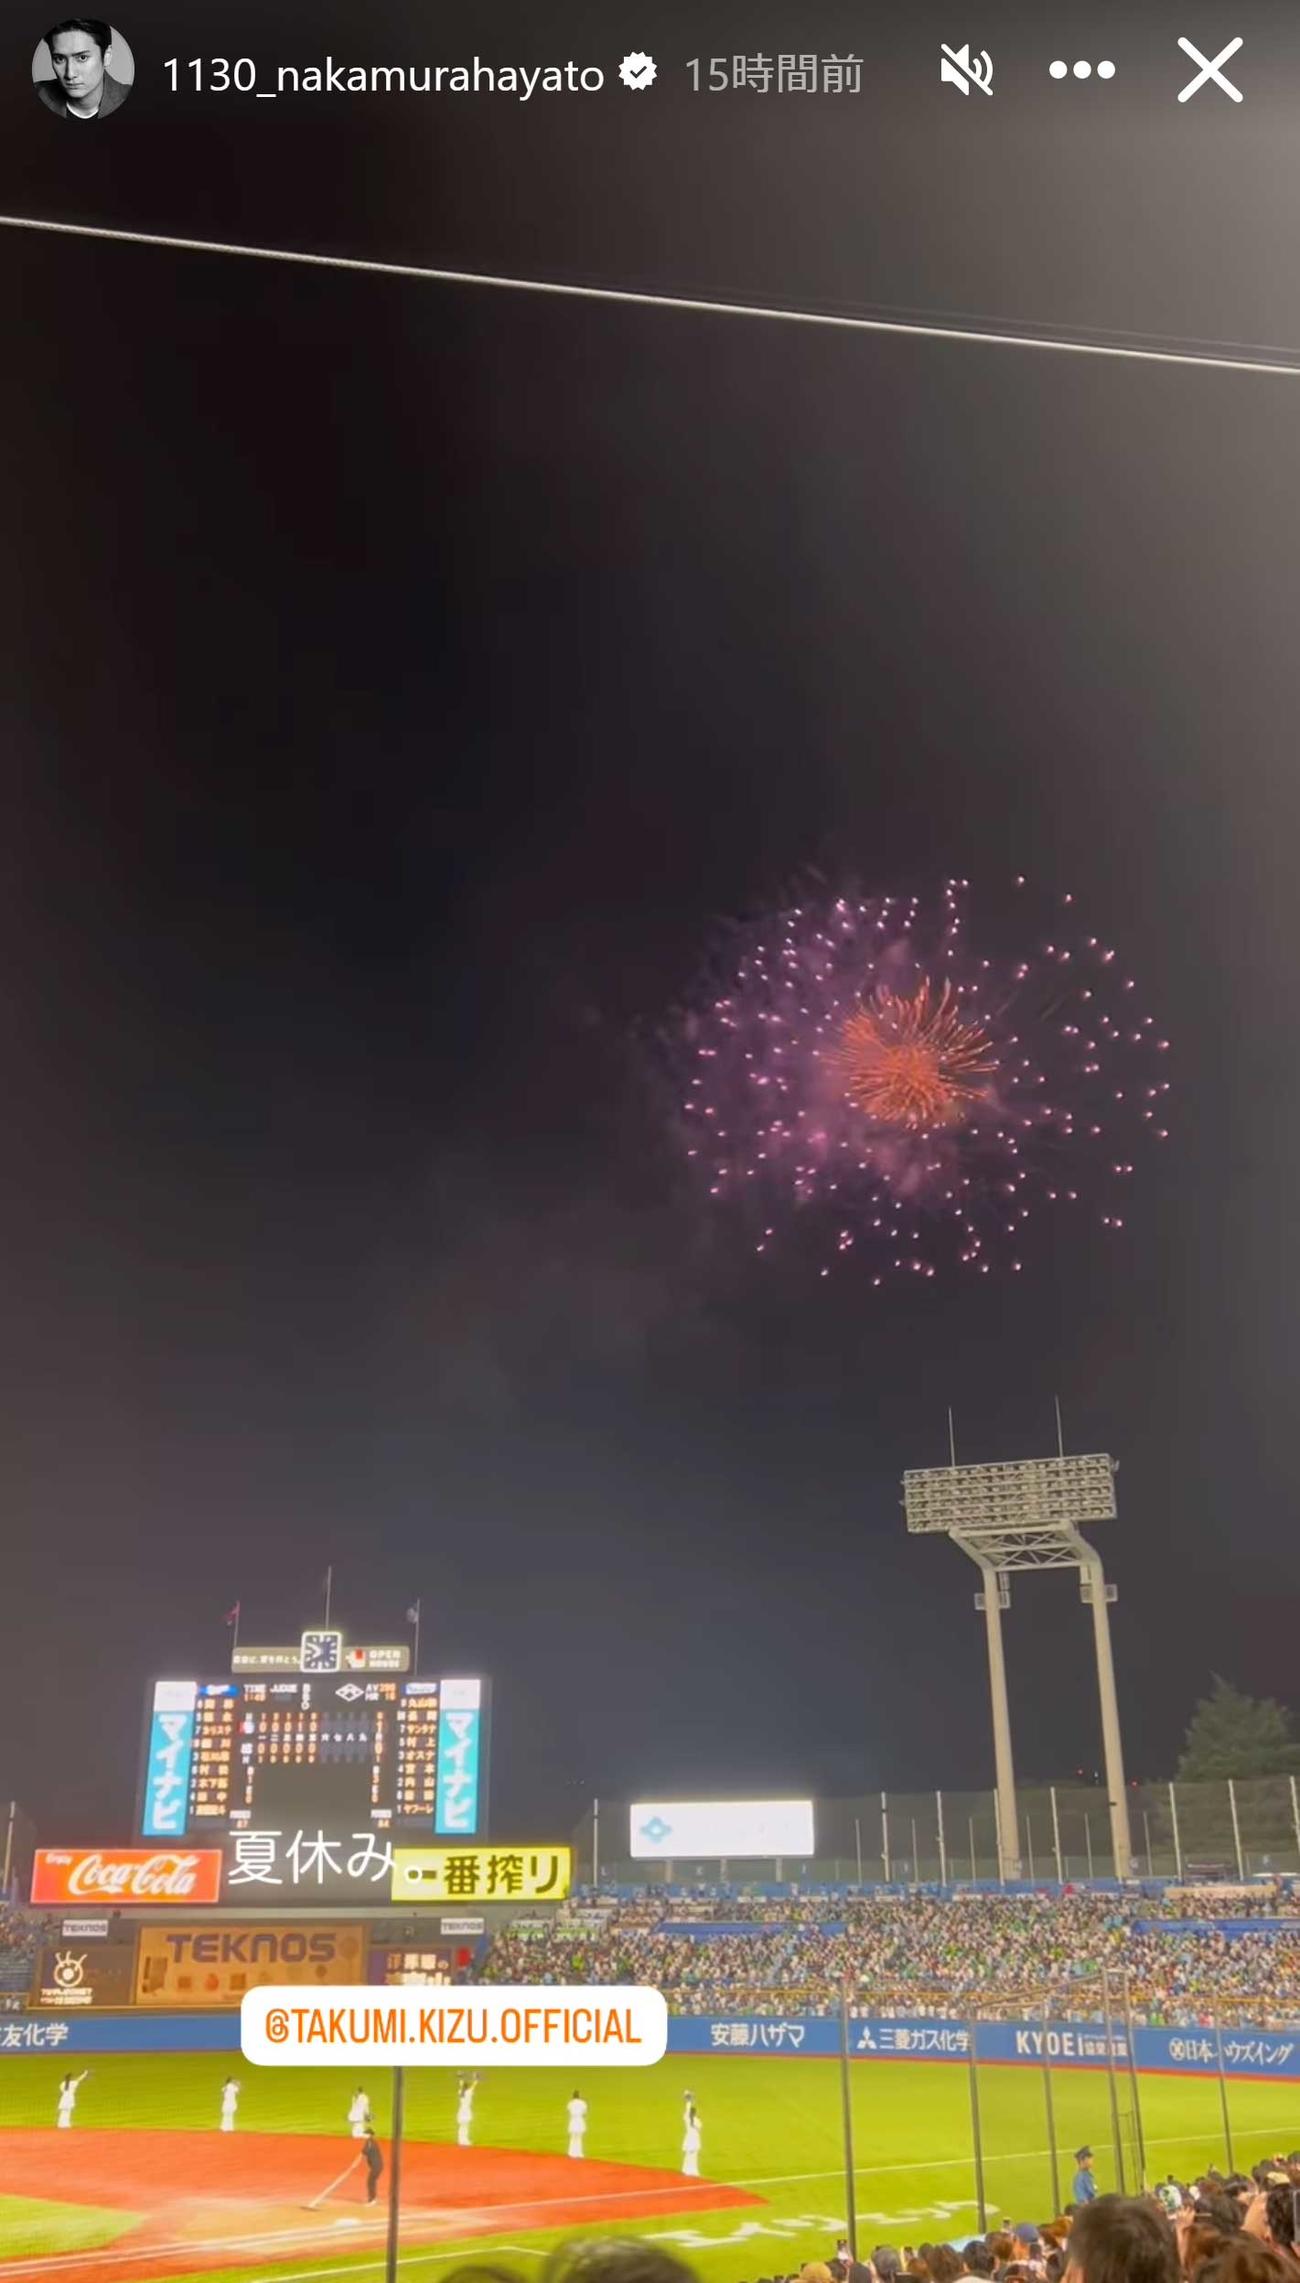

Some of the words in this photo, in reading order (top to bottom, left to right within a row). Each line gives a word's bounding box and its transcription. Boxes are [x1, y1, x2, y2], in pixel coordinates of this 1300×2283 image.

[153, 1713, 188, 1830] マイナビ
[443, 1711, 474, 1829] マイナビ
[68, 1853, 199, 1895] Coca-Cola
[407, 1854, 558, 1894] 一番搾り
[167, 1933, 336, 1963] TEKNOS
[0, 2023, 69, 2047] 友化学
[711, 2022, 805, 2048] 安藤ハザマ
[879, 2028, 971, 2052] 三菱ガス化学
